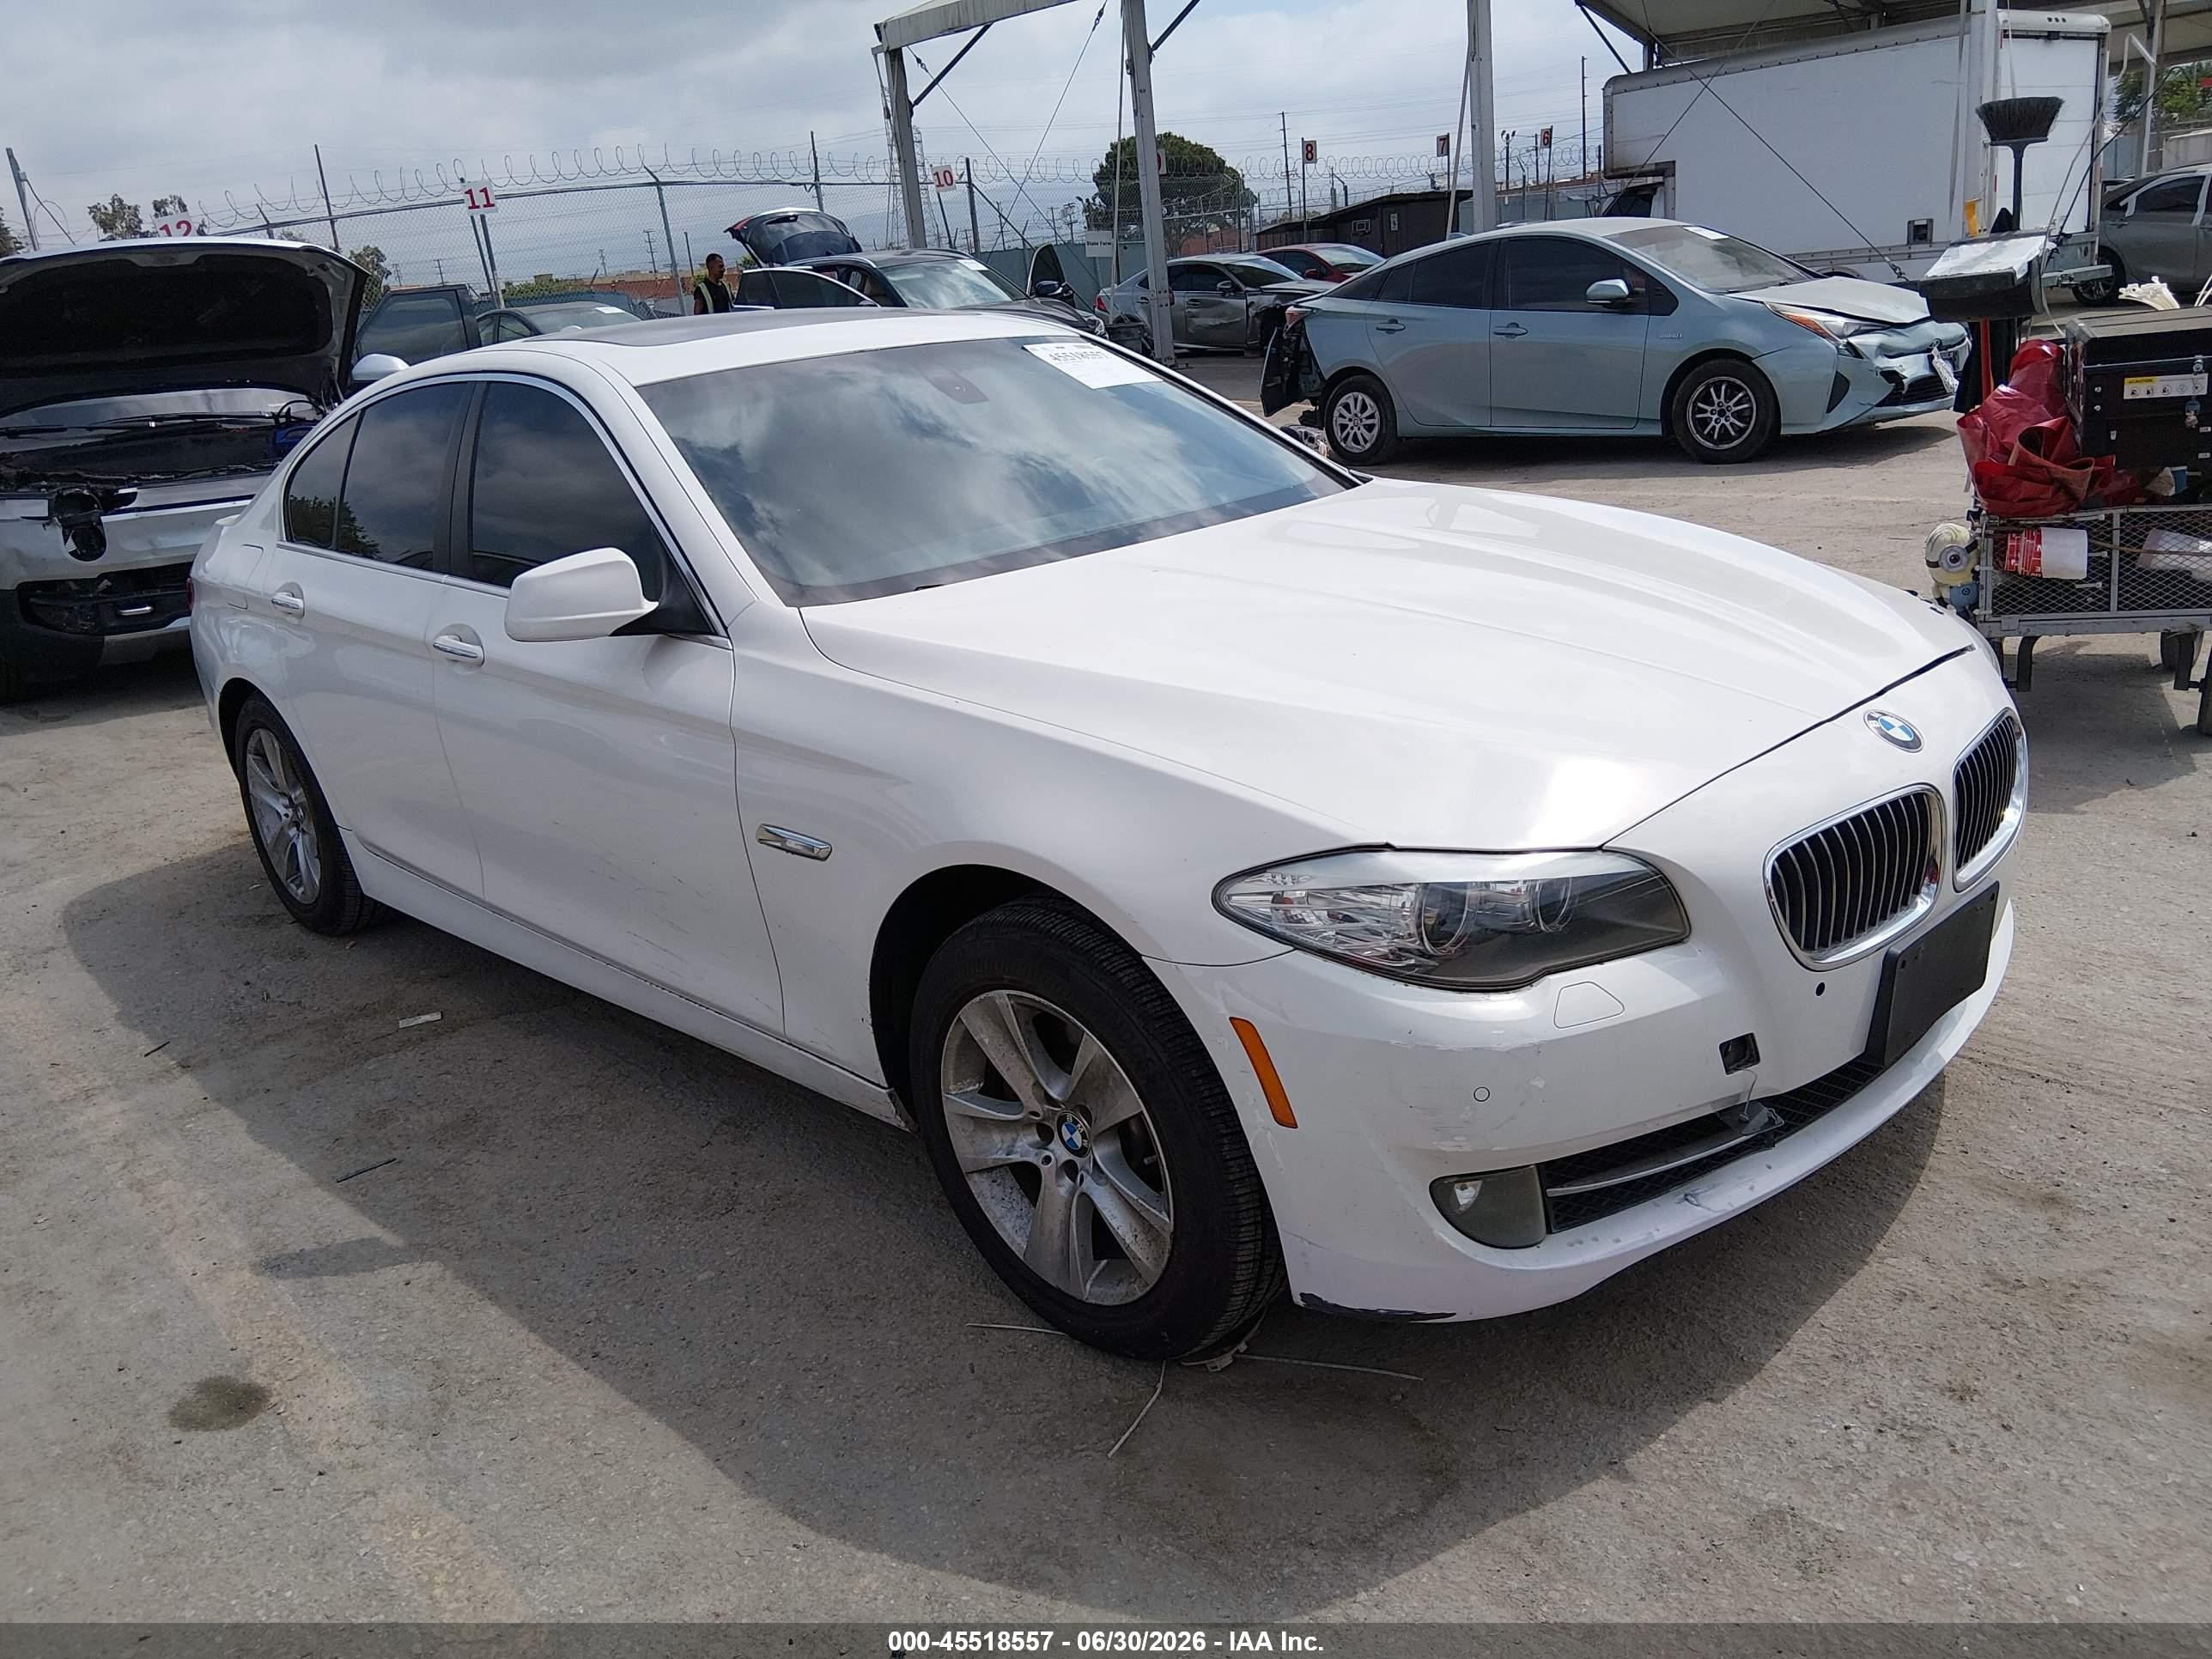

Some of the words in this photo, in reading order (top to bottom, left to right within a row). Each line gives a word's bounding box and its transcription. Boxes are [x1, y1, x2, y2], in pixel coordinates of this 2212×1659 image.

[1439, 137, 1448, 155] 7
[1542, 131, 1550, 146] 6
[1305, 143, 1314, 161] 8
[933, 170, 954, 187] 10
[465, 186, 495, 210] 11
